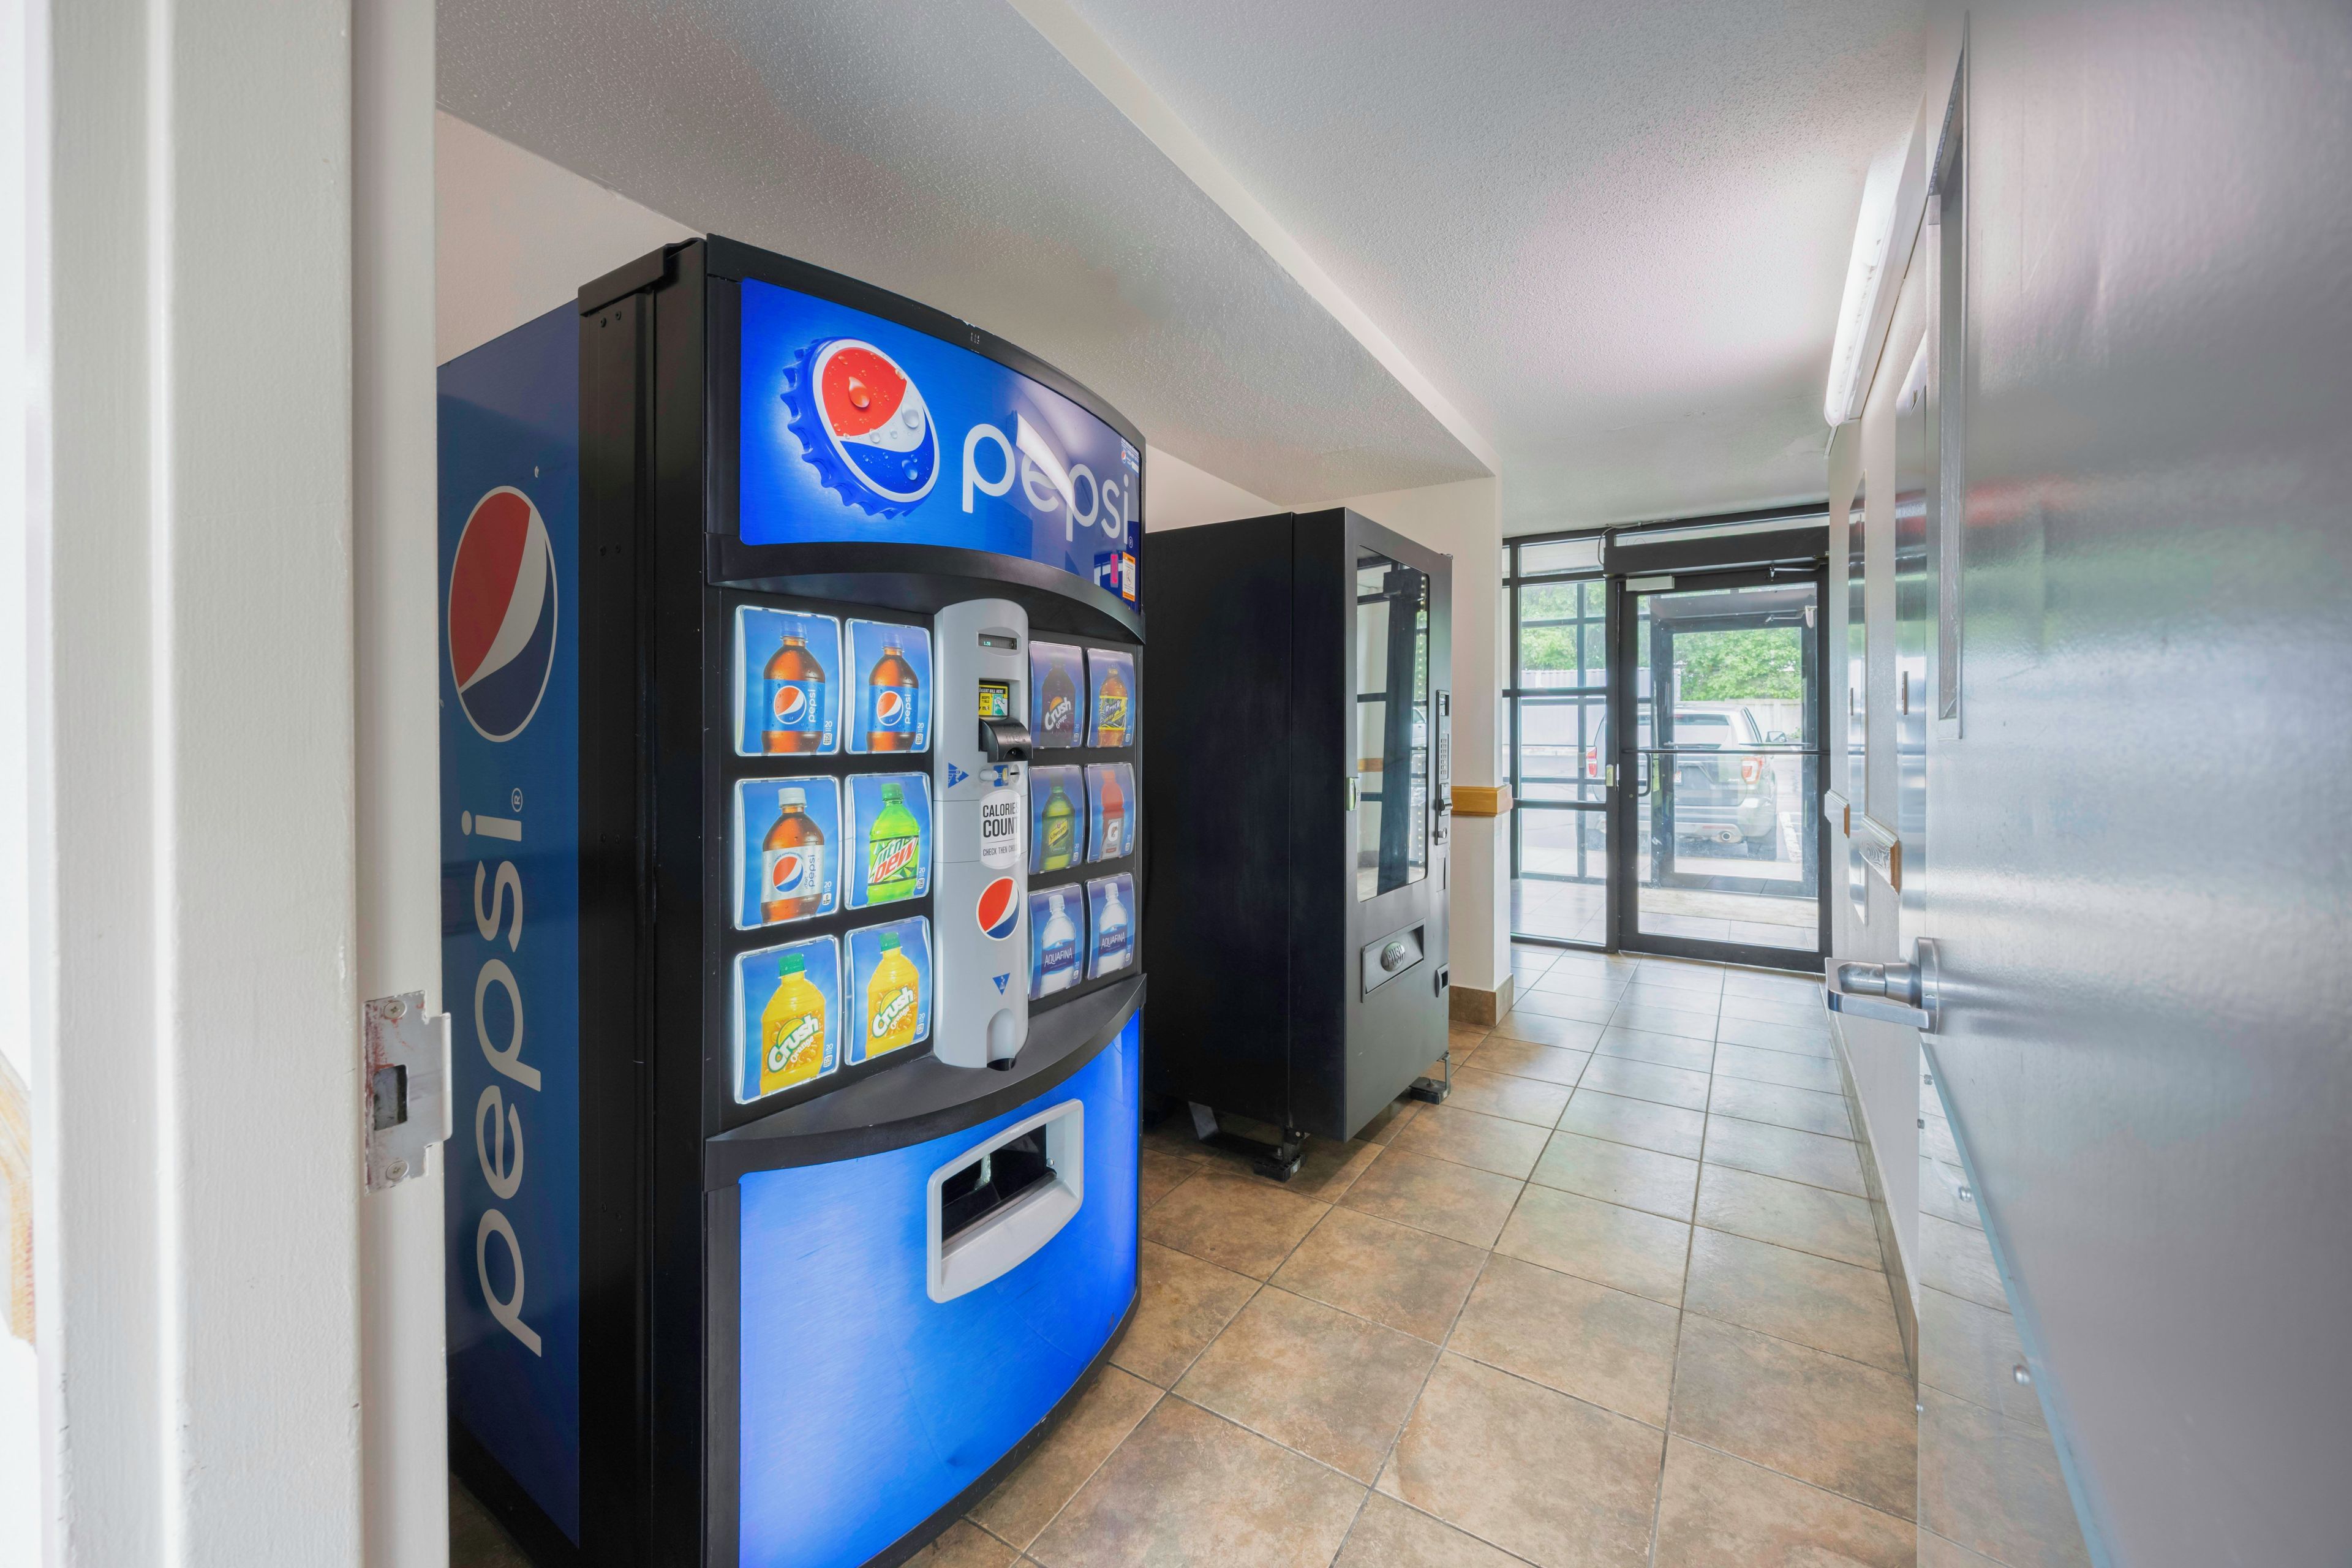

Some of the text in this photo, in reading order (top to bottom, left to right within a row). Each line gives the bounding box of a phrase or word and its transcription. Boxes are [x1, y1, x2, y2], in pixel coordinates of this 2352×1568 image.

[962, 423, 1128, 545] pepsi
[1045, 696, 1071, 730] Crush
[983, 816, 1019, 838] COUNT
[1108, 821, 1118, 842] G
[982, 848, 997, 856] CHECK
[998, 846, 1008, 854] THEN
[1101, 932, 1126, 949] AQUAFINA
[1044, 947, 1072, 967] AQUAFINA
[1384, 944, 1405, 968] PUSH
[873, 987, 913, 1036] Crush
[891, 1005, 910, 1030] Orange
[769, 1014, 819, 1071] Crush
[790, 1036, 814, 1063] Orange
[461, 809, 542, 1358] pepsi
